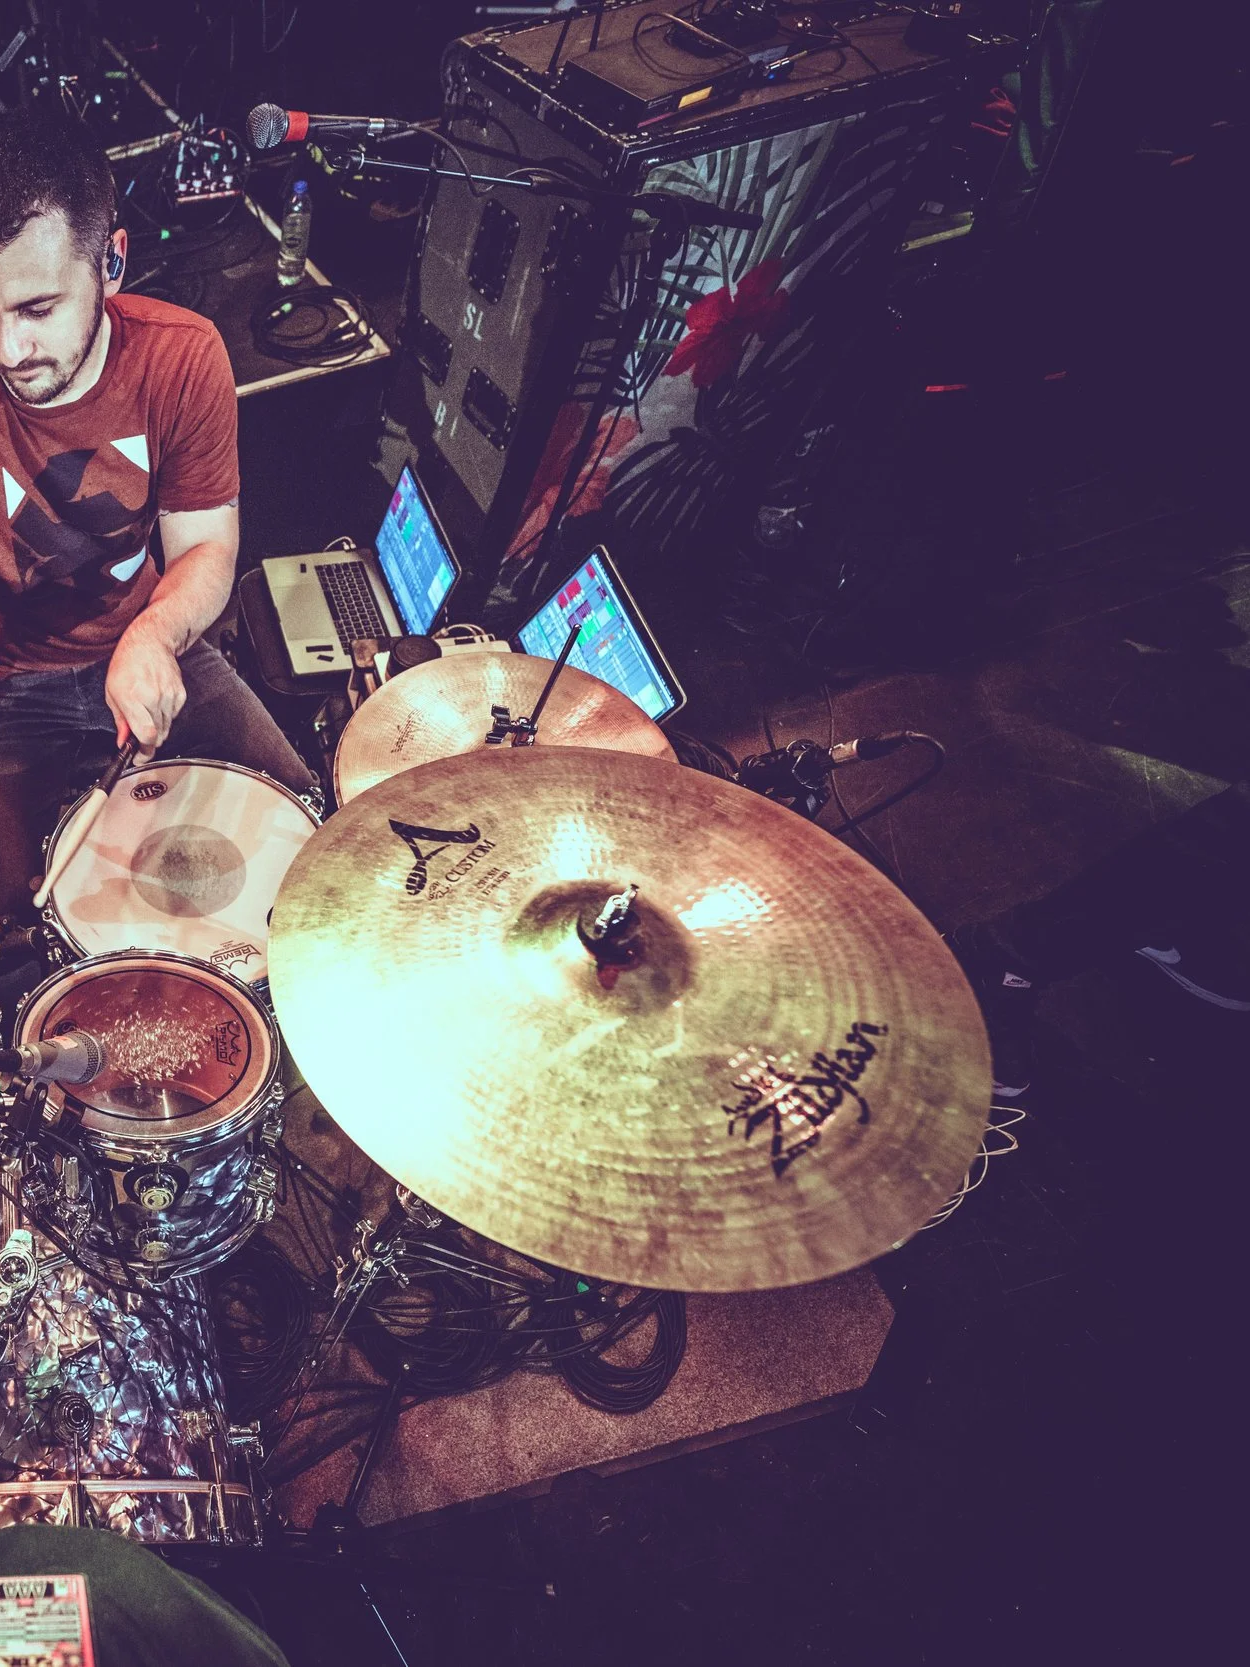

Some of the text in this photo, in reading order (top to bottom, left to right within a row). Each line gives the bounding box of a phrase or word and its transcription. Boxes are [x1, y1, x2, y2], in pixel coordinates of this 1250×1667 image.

[463, 302, 484, 341] SL
[134, 785, 162, 799] SIR
[445, 839, 496, 883] CUSTOM
[214, 947, 251, 963] REMO
[745, 1020, 889, 1178] Zildjian
